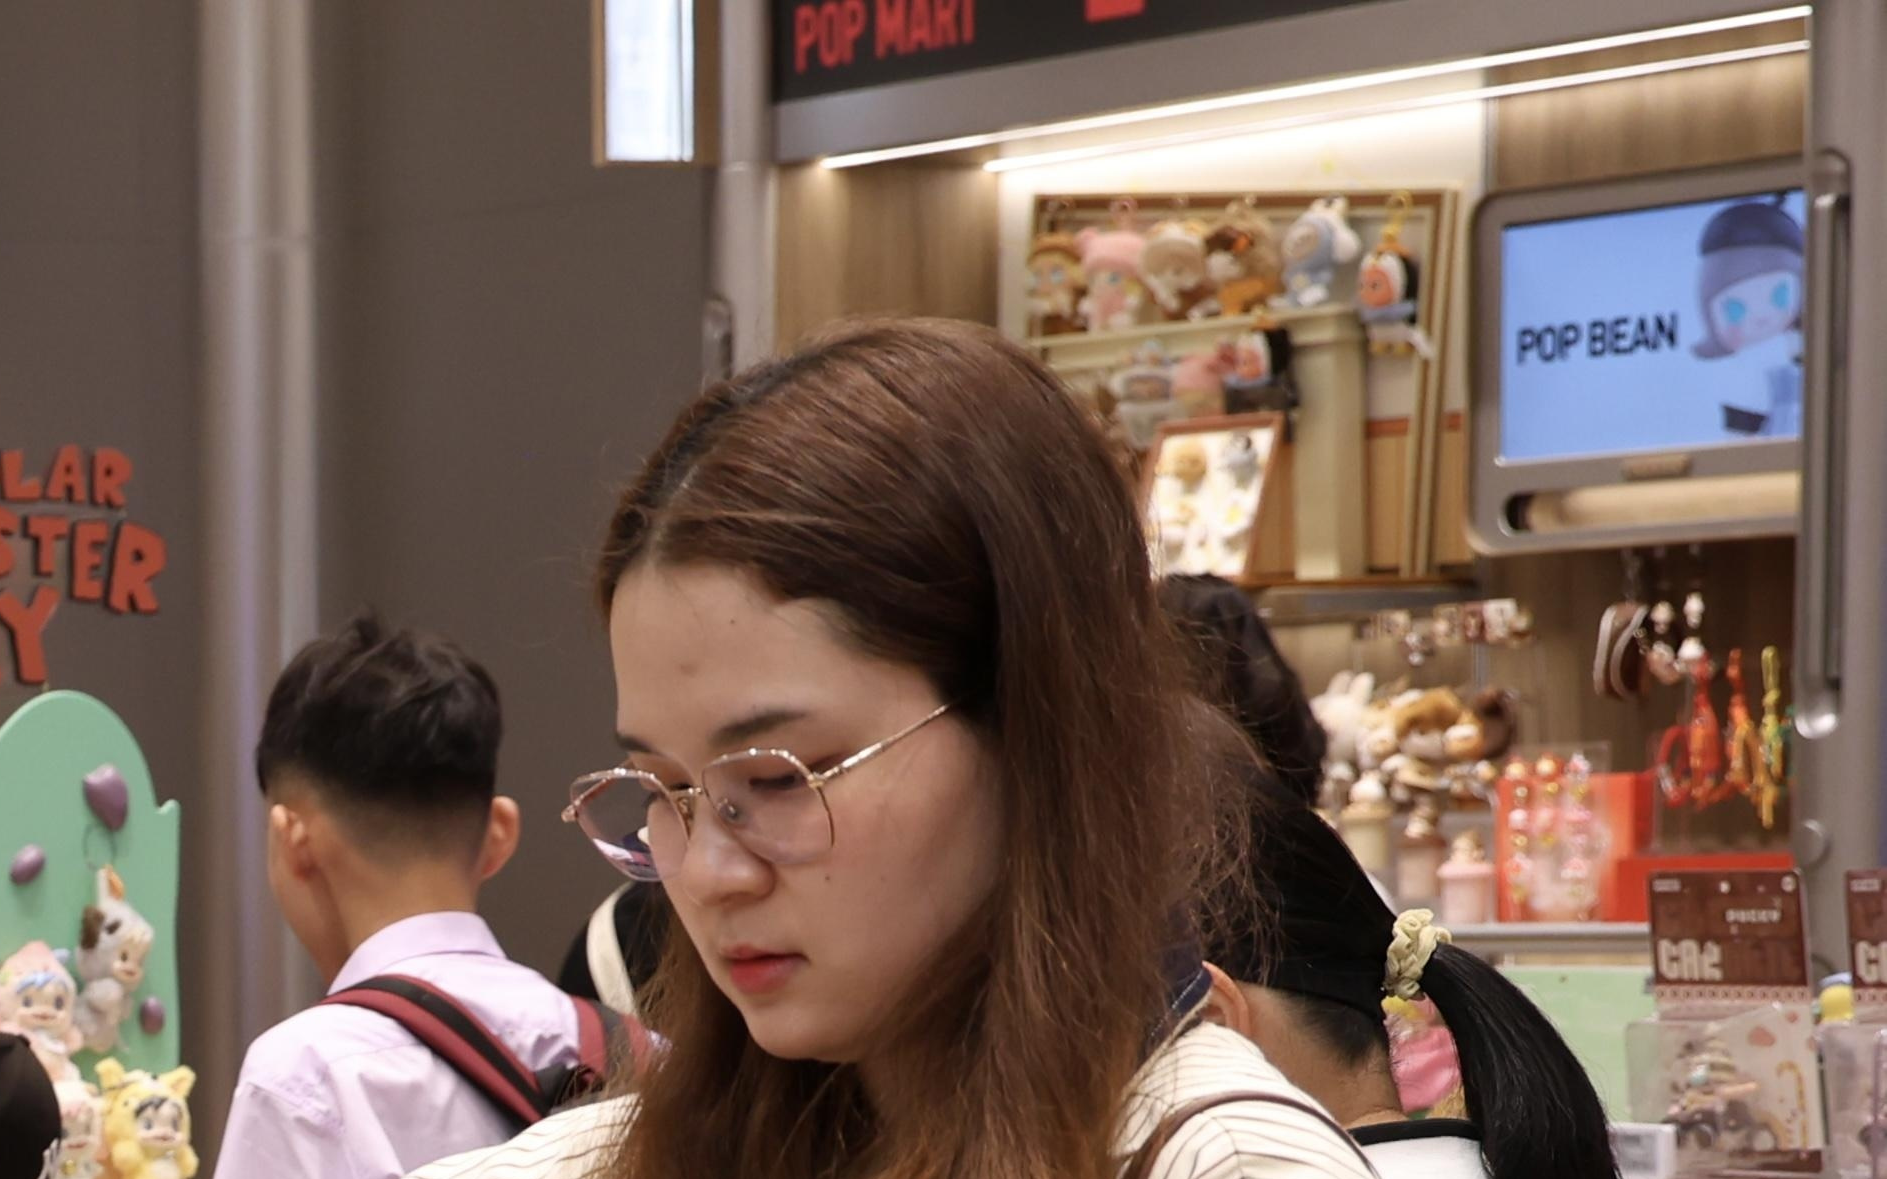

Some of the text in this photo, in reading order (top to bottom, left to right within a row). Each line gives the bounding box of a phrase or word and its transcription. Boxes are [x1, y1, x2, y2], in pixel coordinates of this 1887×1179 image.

[795, 0, 974, 74] POP MART
[1516, 310, 1678, 366] POP BEAN
